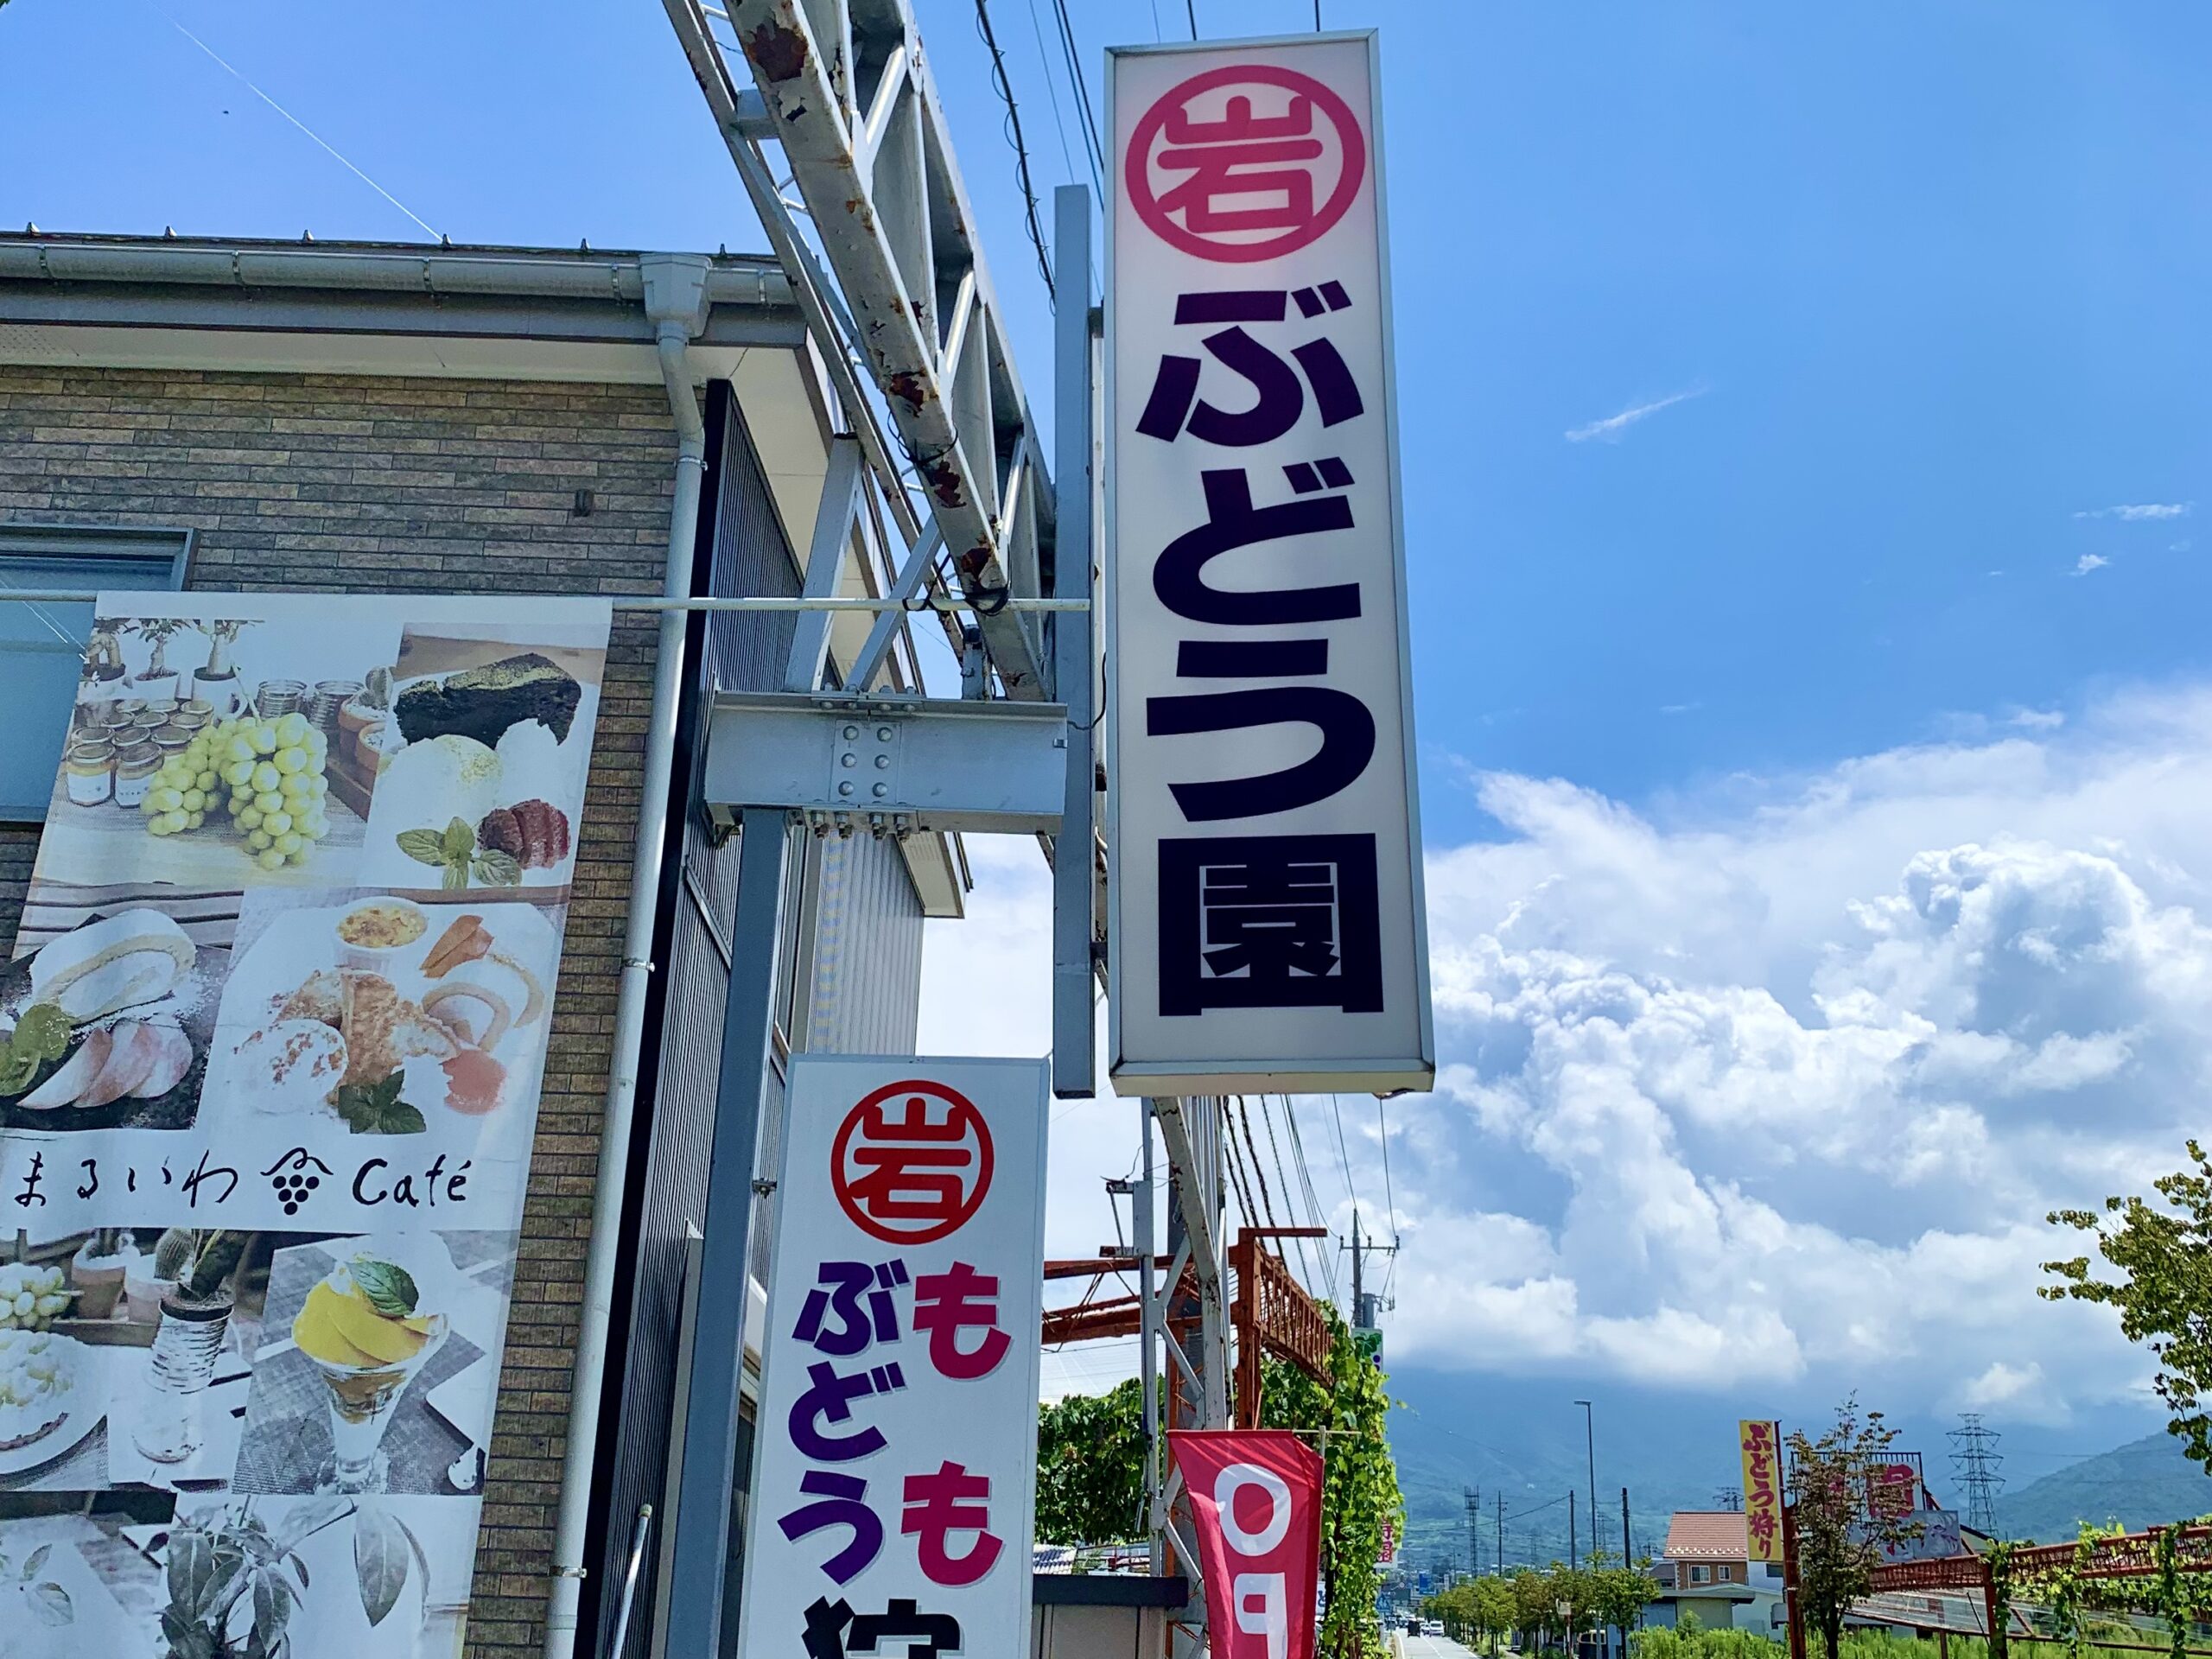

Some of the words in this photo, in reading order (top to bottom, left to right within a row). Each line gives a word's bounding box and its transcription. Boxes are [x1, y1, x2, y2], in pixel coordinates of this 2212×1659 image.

[1151, 92, 1329, 237] 岩
[1135, 280, 1384, 1017] ぶどう園
[14, 1148, 238, 1208] まるいわ
[352, 1154, 471, 1207] Café
[850, 1096, 973, 1219] 岩
[900, 1261, 1012, 1586] もも
[1742, 1422, 1779, 1560] ぶどう狩り
